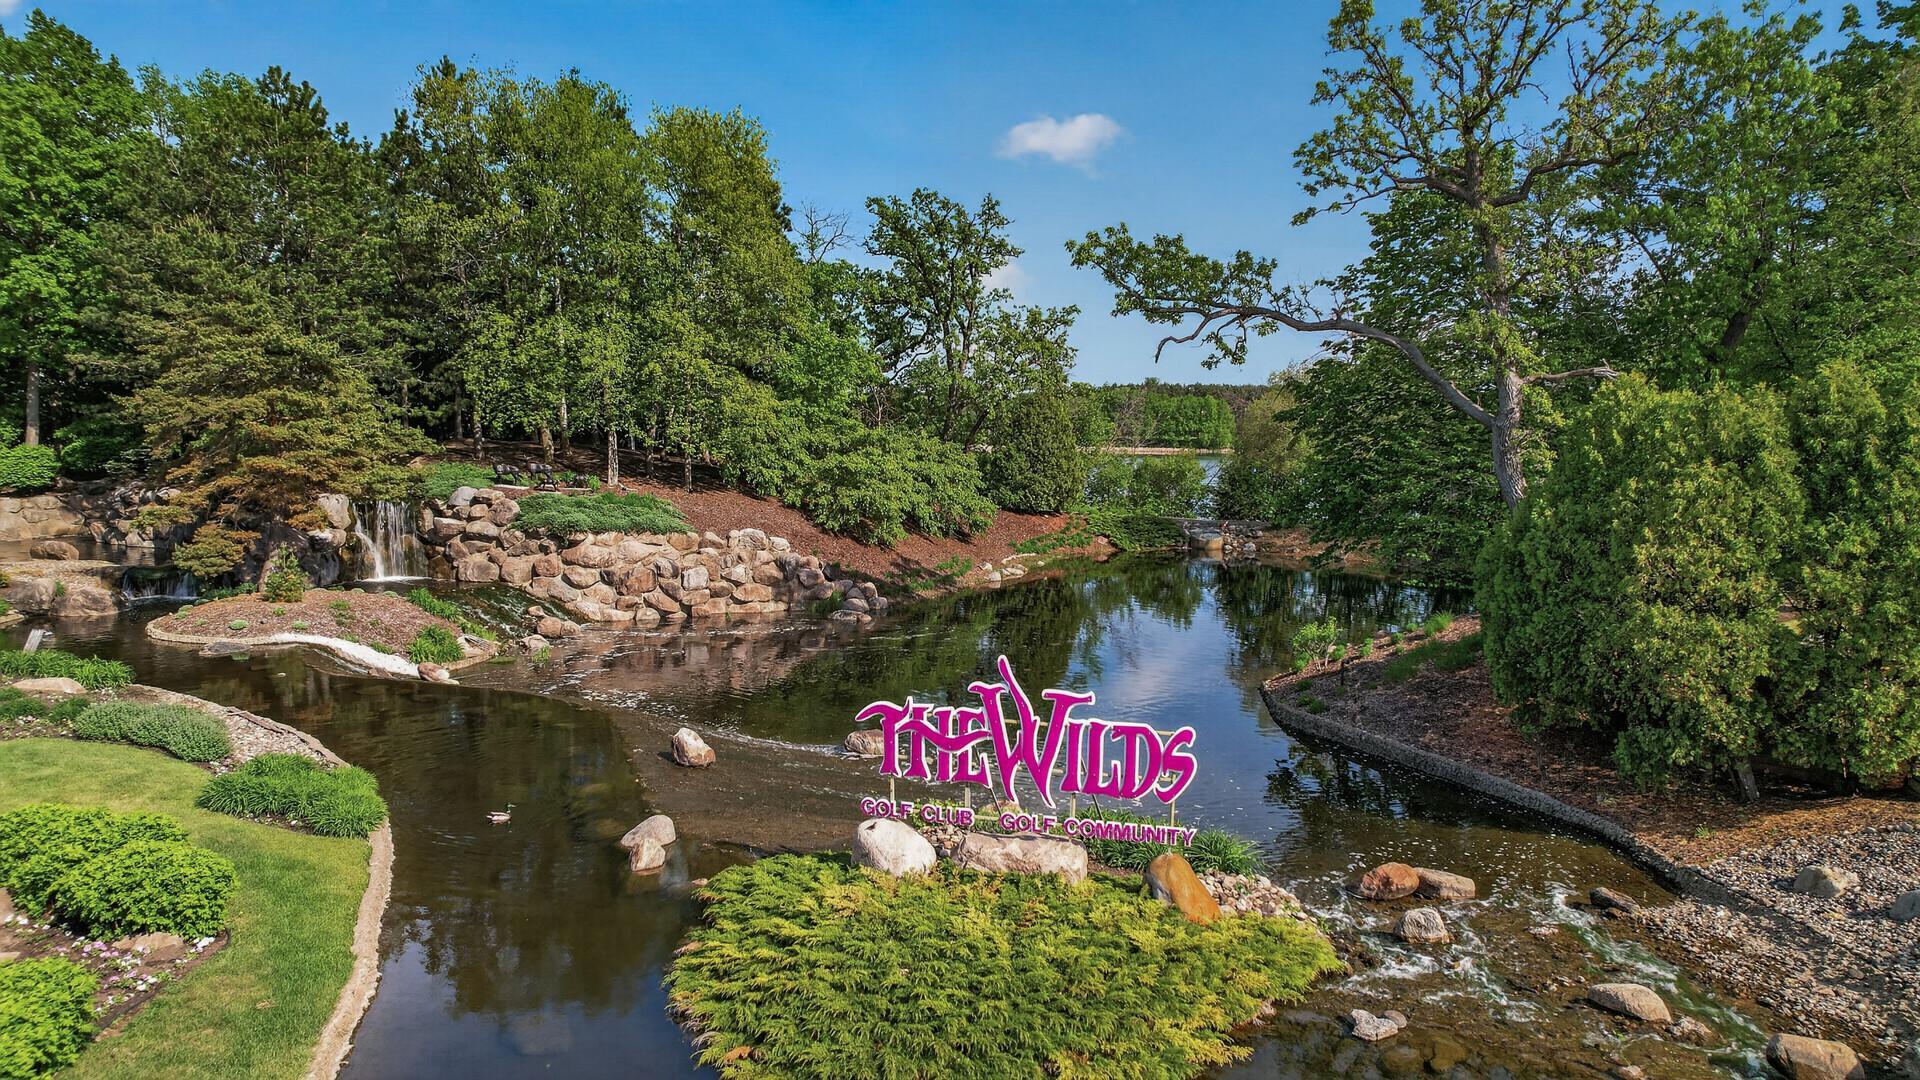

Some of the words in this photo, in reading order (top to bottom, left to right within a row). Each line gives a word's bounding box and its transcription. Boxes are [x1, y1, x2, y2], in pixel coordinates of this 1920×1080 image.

[855, 696, 992, 789] THE
[968, 654, 1198, 808] WILDS
[860, 797, 914, 819] GOLF
[921, 803, 975, 827] CLUB
[1000, 812, 1056, 835] GOLF
[1063, 818, 1198, 847] COMMUNITY
